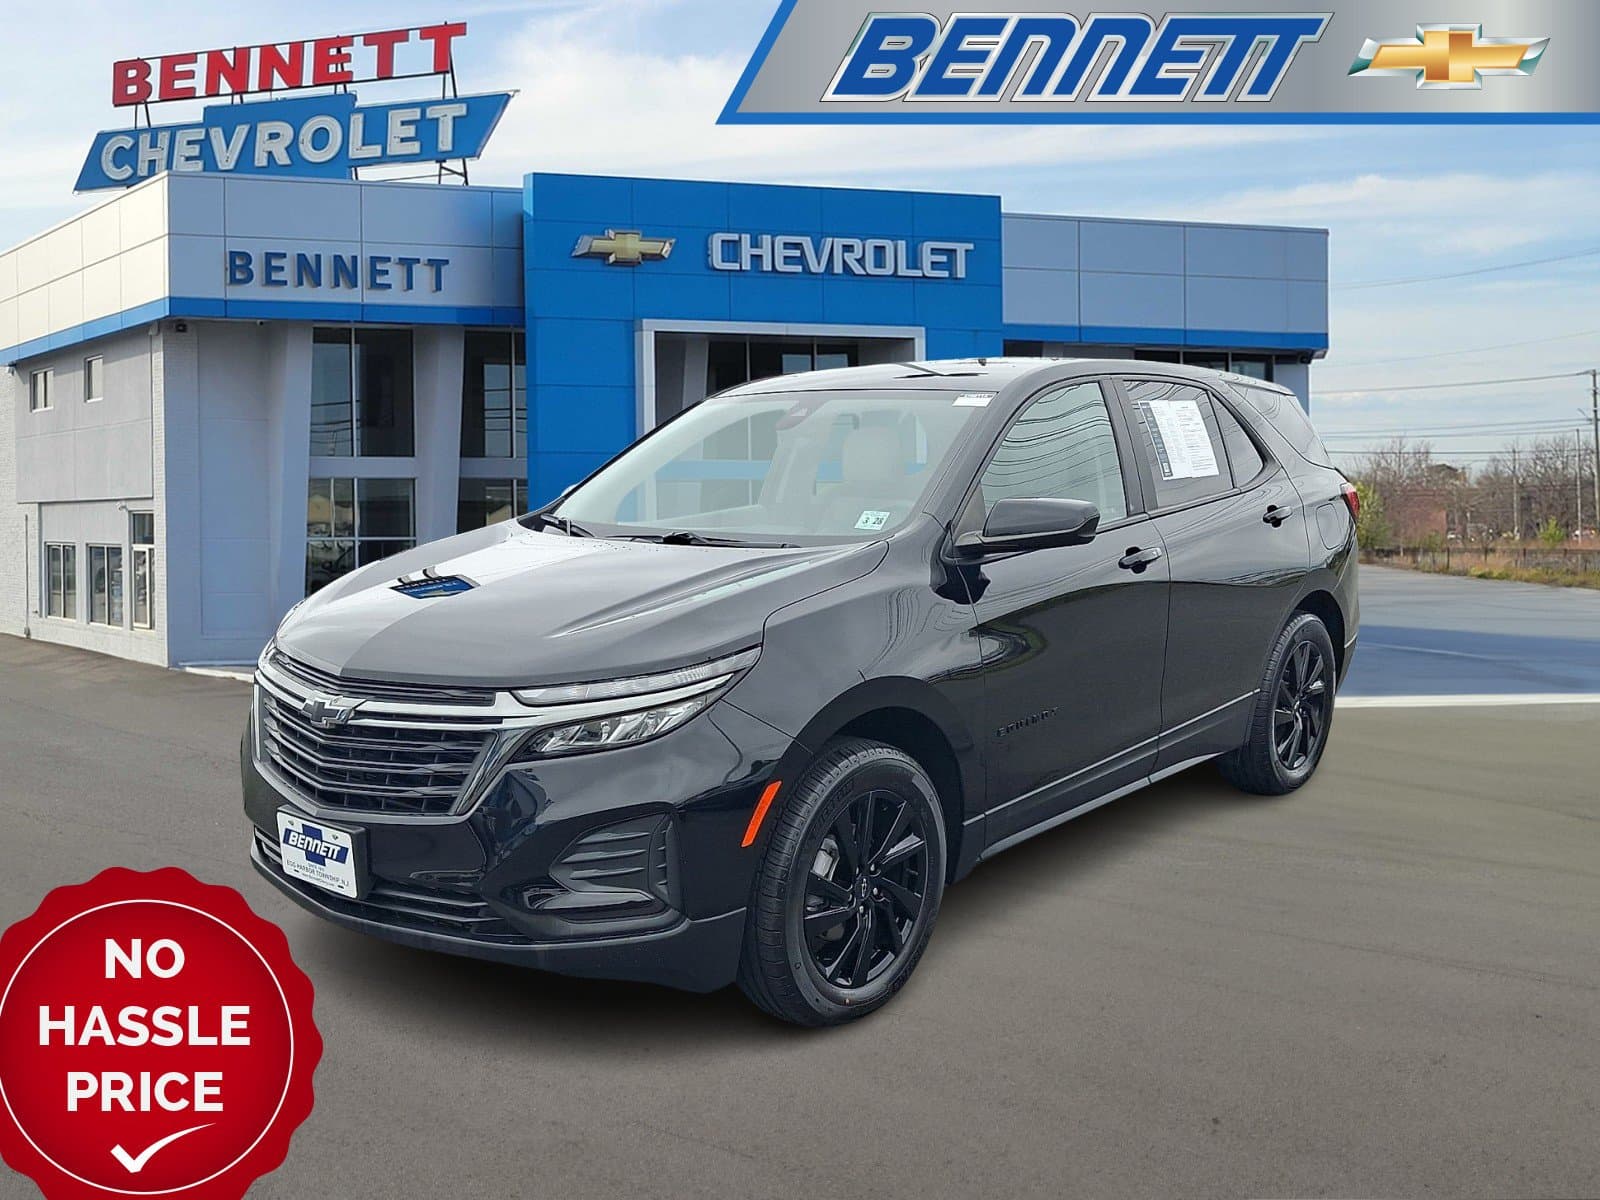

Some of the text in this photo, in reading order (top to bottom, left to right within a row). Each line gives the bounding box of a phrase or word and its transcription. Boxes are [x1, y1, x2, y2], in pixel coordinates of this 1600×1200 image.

[112, 22, 467, 107] BENNETT
[100, 103, 467, 181] CHEVROLET
[226, 249, 450, 293] BENNETT
[708, 232, 975, 280] CHEVROLET
[288, 831, 341, 860] BENNETT
